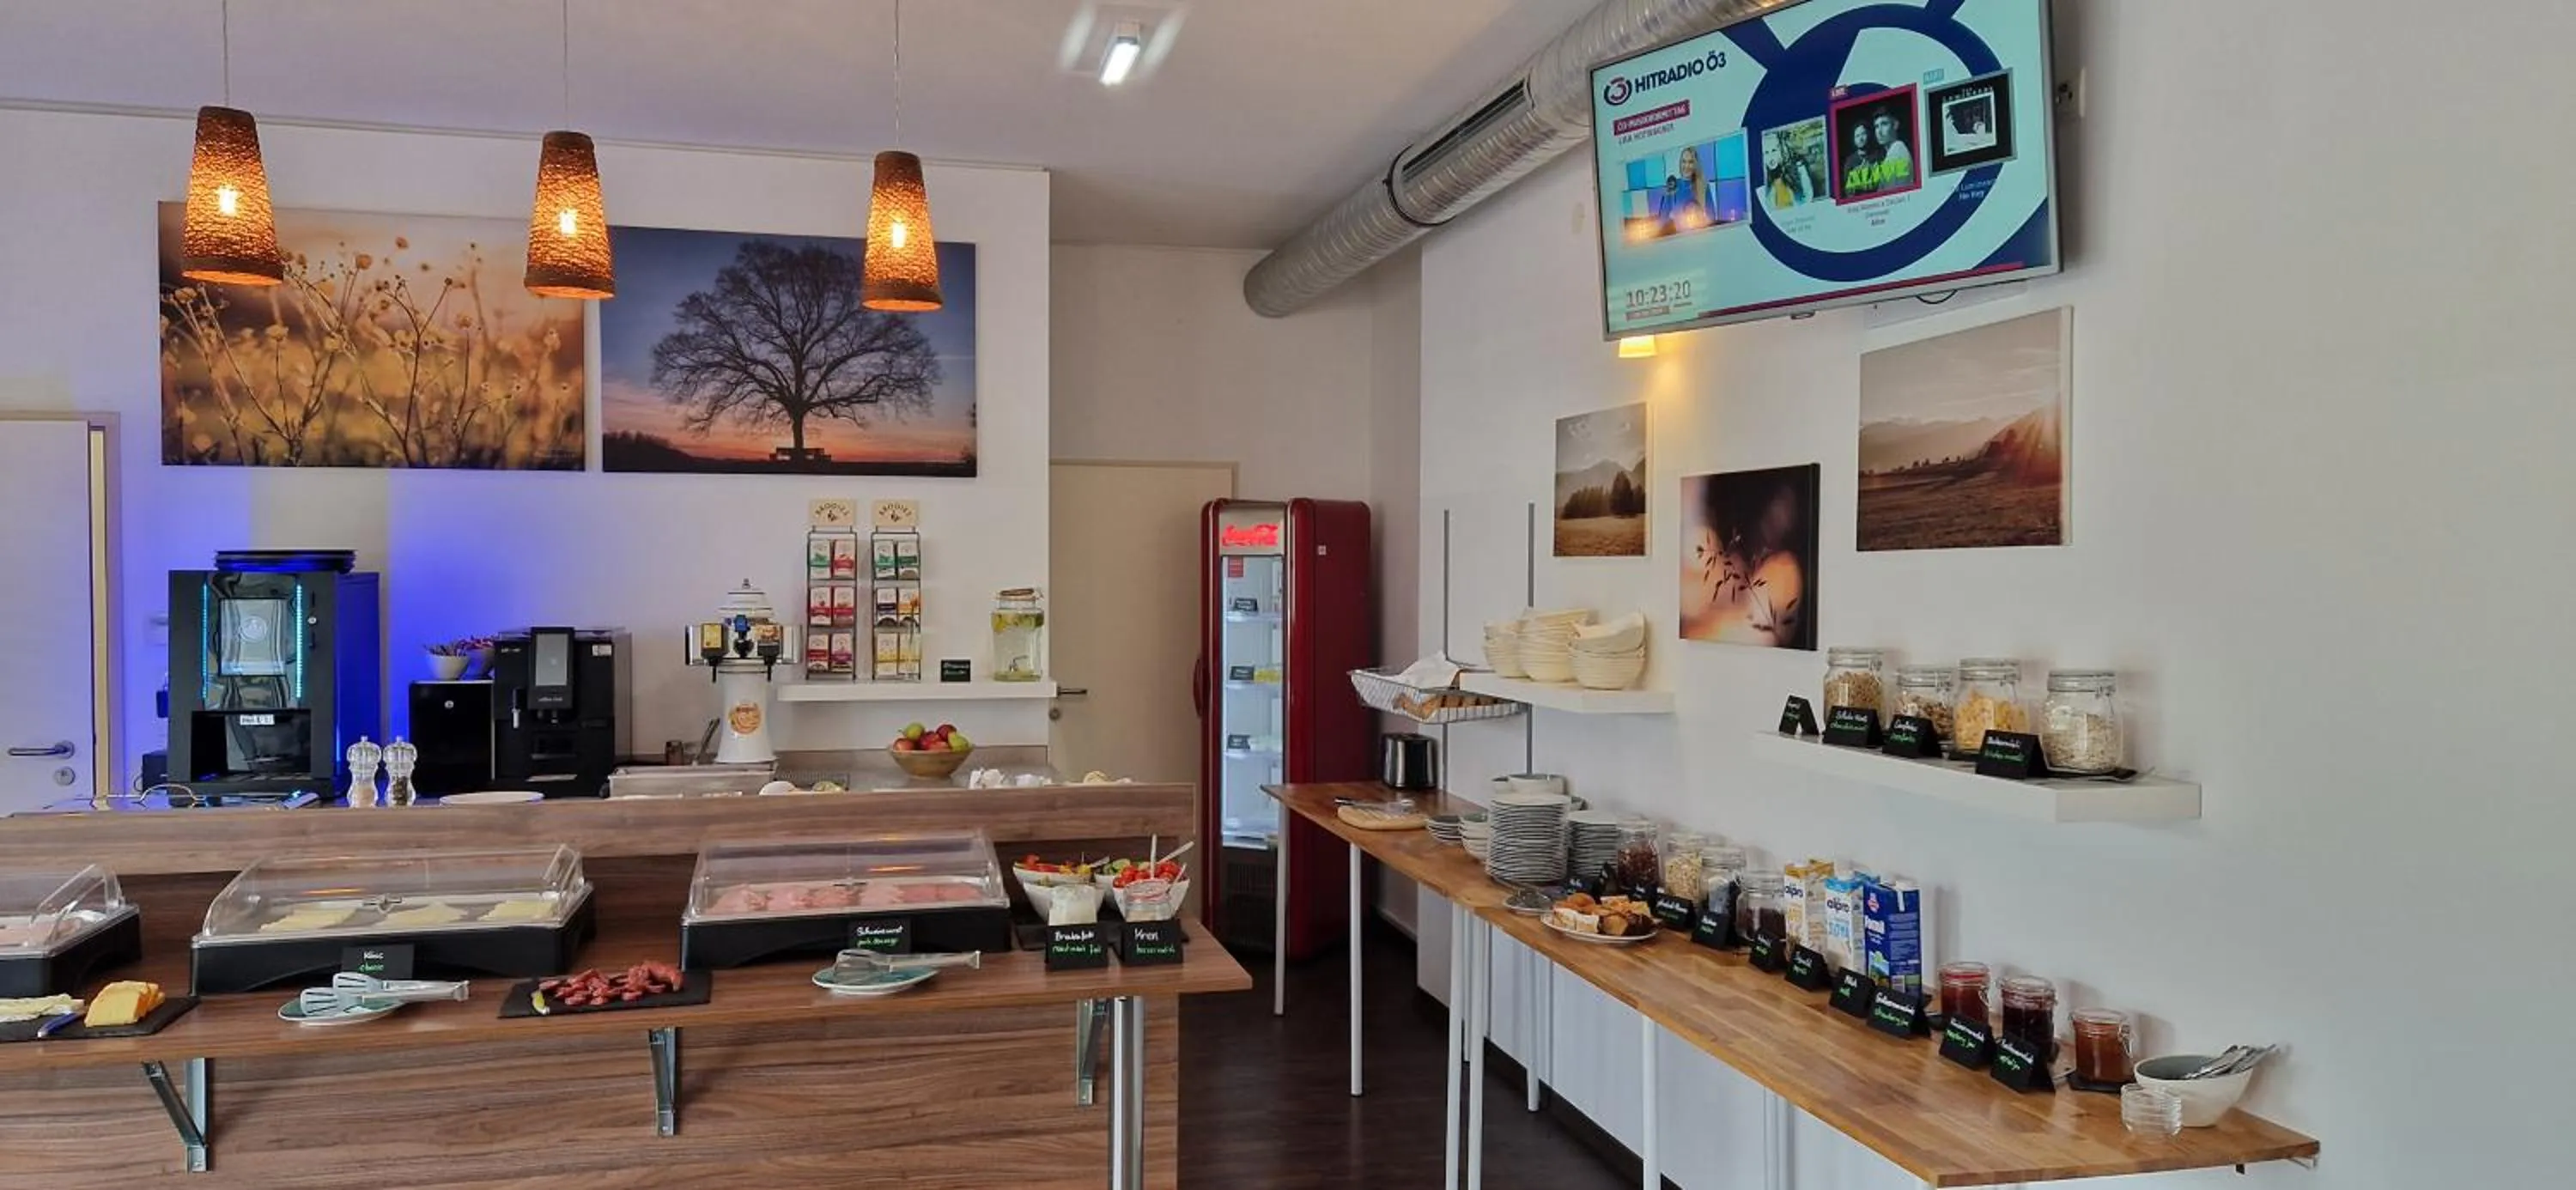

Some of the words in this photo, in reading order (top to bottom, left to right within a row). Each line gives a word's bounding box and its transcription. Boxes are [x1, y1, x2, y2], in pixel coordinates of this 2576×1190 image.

[1635, 59, 1704, 94] HITRADIO
[1706, 50, 1727, 71] Ö3
[1626, 280, 1691, 307] 10:23:20
[1826, 897, 1850, 914] alpro
